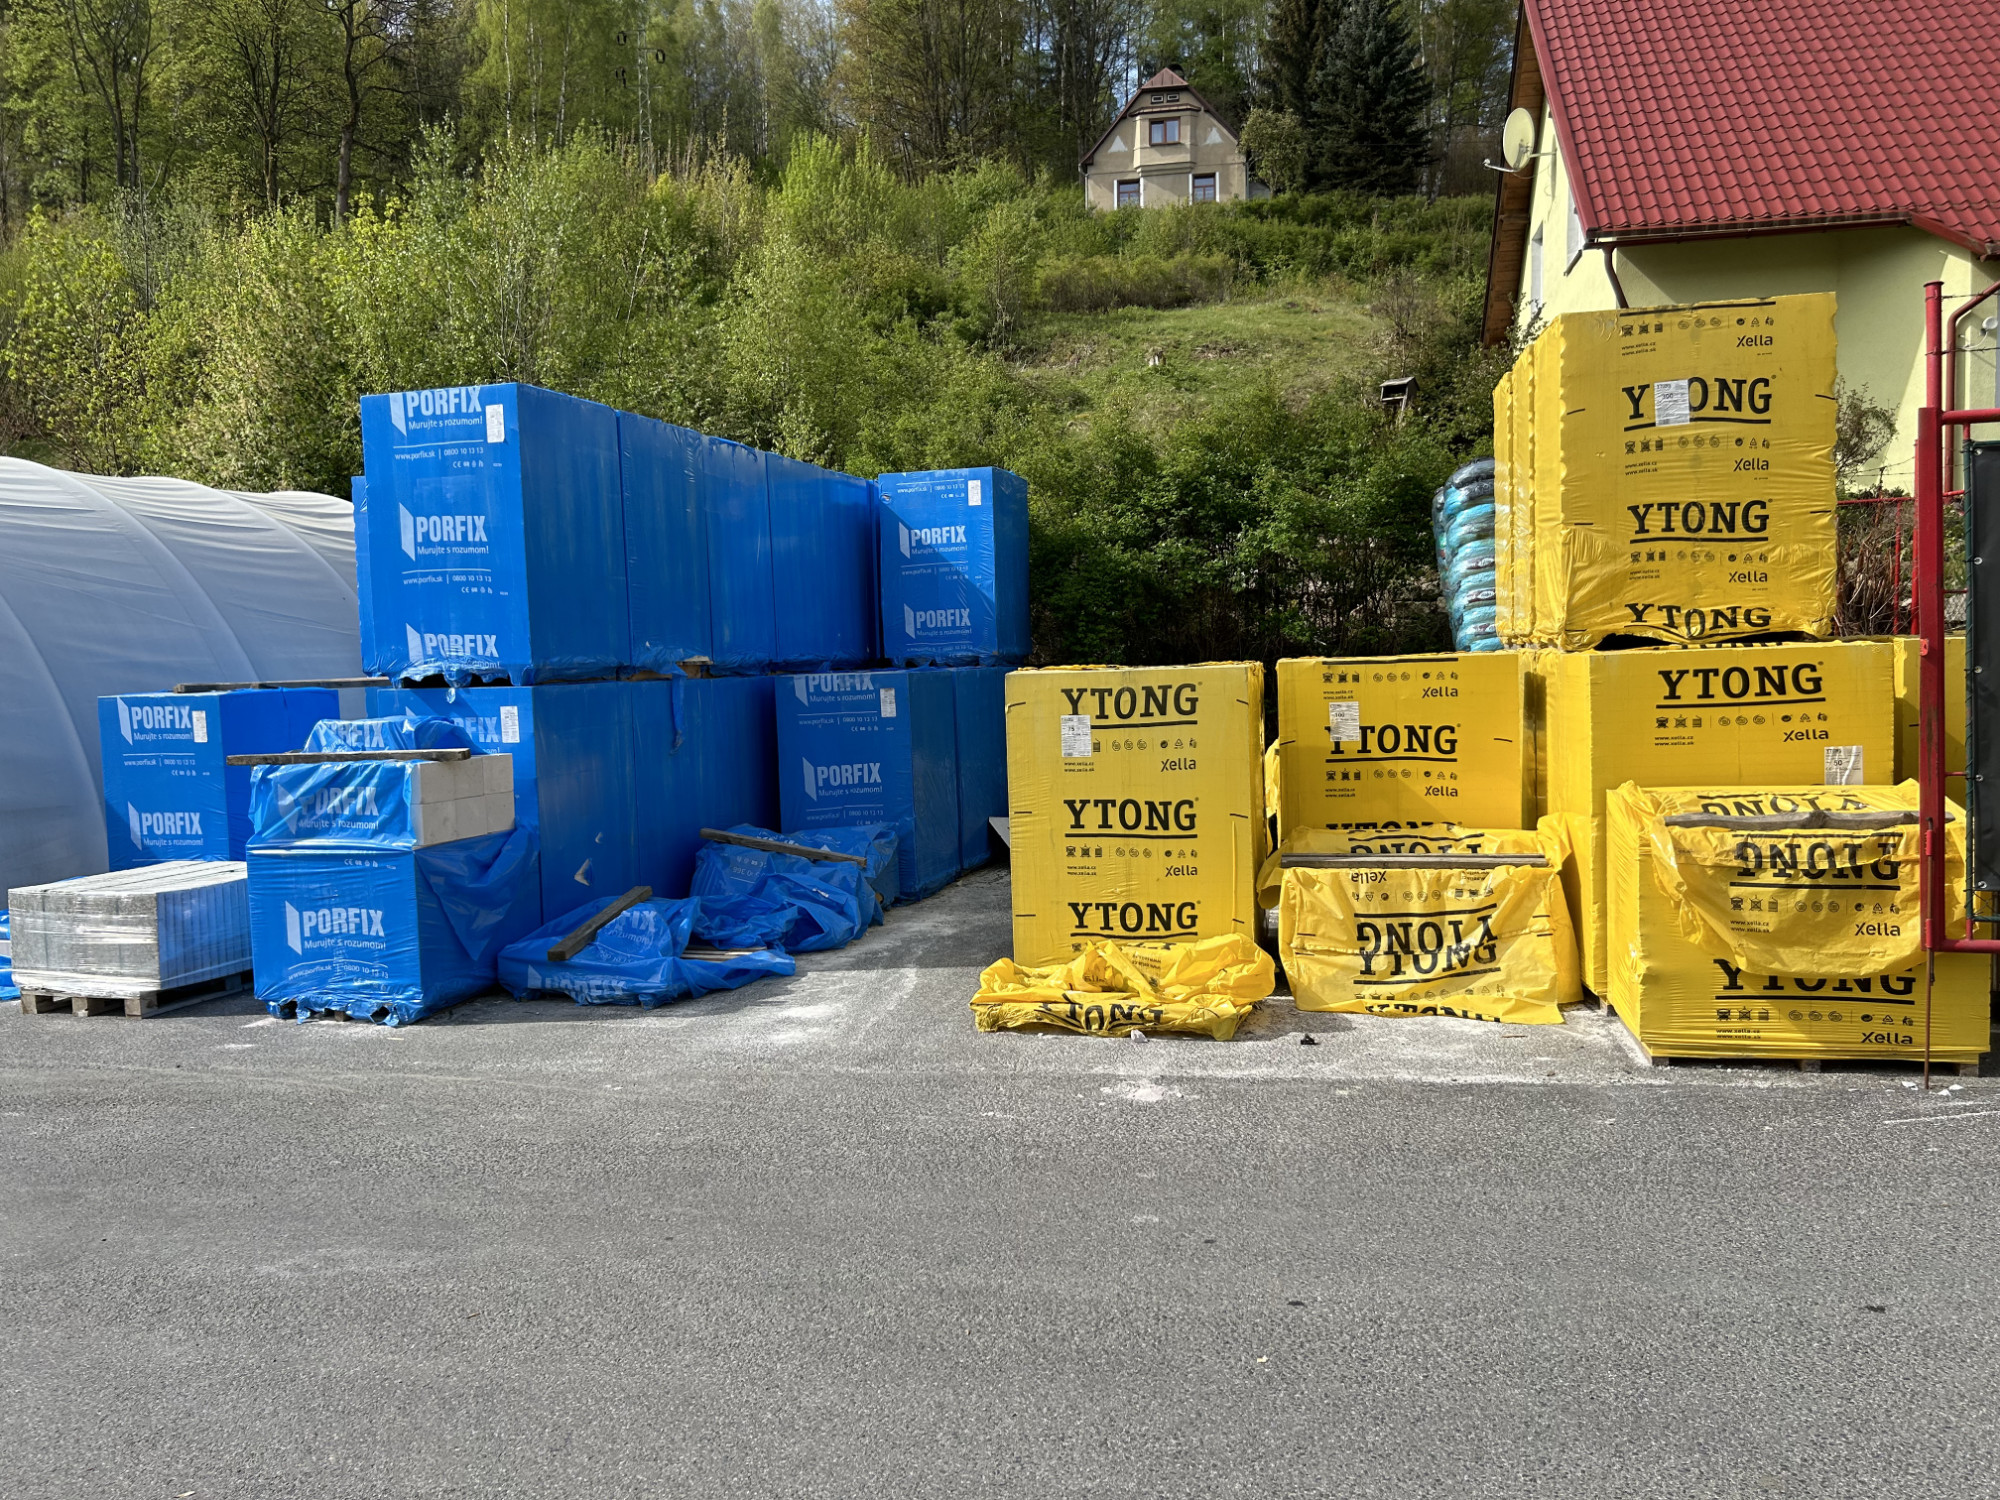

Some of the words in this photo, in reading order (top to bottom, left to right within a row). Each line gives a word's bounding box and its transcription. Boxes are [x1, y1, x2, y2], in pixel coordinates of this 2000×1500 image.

[1736, 335, 1773, 348] Xella
[406, 386, 482, 418] PORFIX
[1621, 377, 1773, 420] YONG
[408, 420, 438, 430] Murujte
[444, 416, 483, 426] rozumom!
[1733, 458, 1770, 472] Xella
[1626, 500, 1770, 535] YTONG
[416, 515, 488, 542] PORFIX
[911, 526, 966, 547] PORFIX
[417, 546, 446, 556] Murujte
[452, 546, 490, 554] rozumom!
[1728, 570, 1768, 583] Xella
[916, 608, 972, 628] PORFIX
[1624, 603, 1772, 639] YTONG
[808, 674, 874, 693] PORFIX
[1658, 663, 1823, 700] YTONG
[810, 694, 836, 704] Murujte
[842, 692, 876, 700] rozumom!
[1060, 683, 1199, 719] YTONG
[1422, 686, 1458, 699] Xella
[131, 706, 192, 730] PORFIX
[134, 732, 157, 742] Murujte
[162, 732, 194, 740] rozumom!
[451, 716, 500, 742] FIX
[1783, 728, 1829, 743] Xella
[1160, 758, 1197, 772] Xella
[816, 762, 882, 787] PORFIX
[818, 789, 844, 797] Murujte
[1424, 786, 1458, 798] Xella
[1063, 798, 1197, 831] YTONG
[142, 812, 202, 835] PORFIX
[338, 820, 378, 830] rozumom!
[1165, 865, 1198, 878] Xella
[302, 908, 385, 938] PORFIX
[1068, 902, 1198, 932] YTONG
[1855, 922, 1901, 937] Xella
[304, 938, 336, 949] Murujte
[344, 940, 386, 950] rozumom!
[1862, 1032, 1913, 1044] Xella
